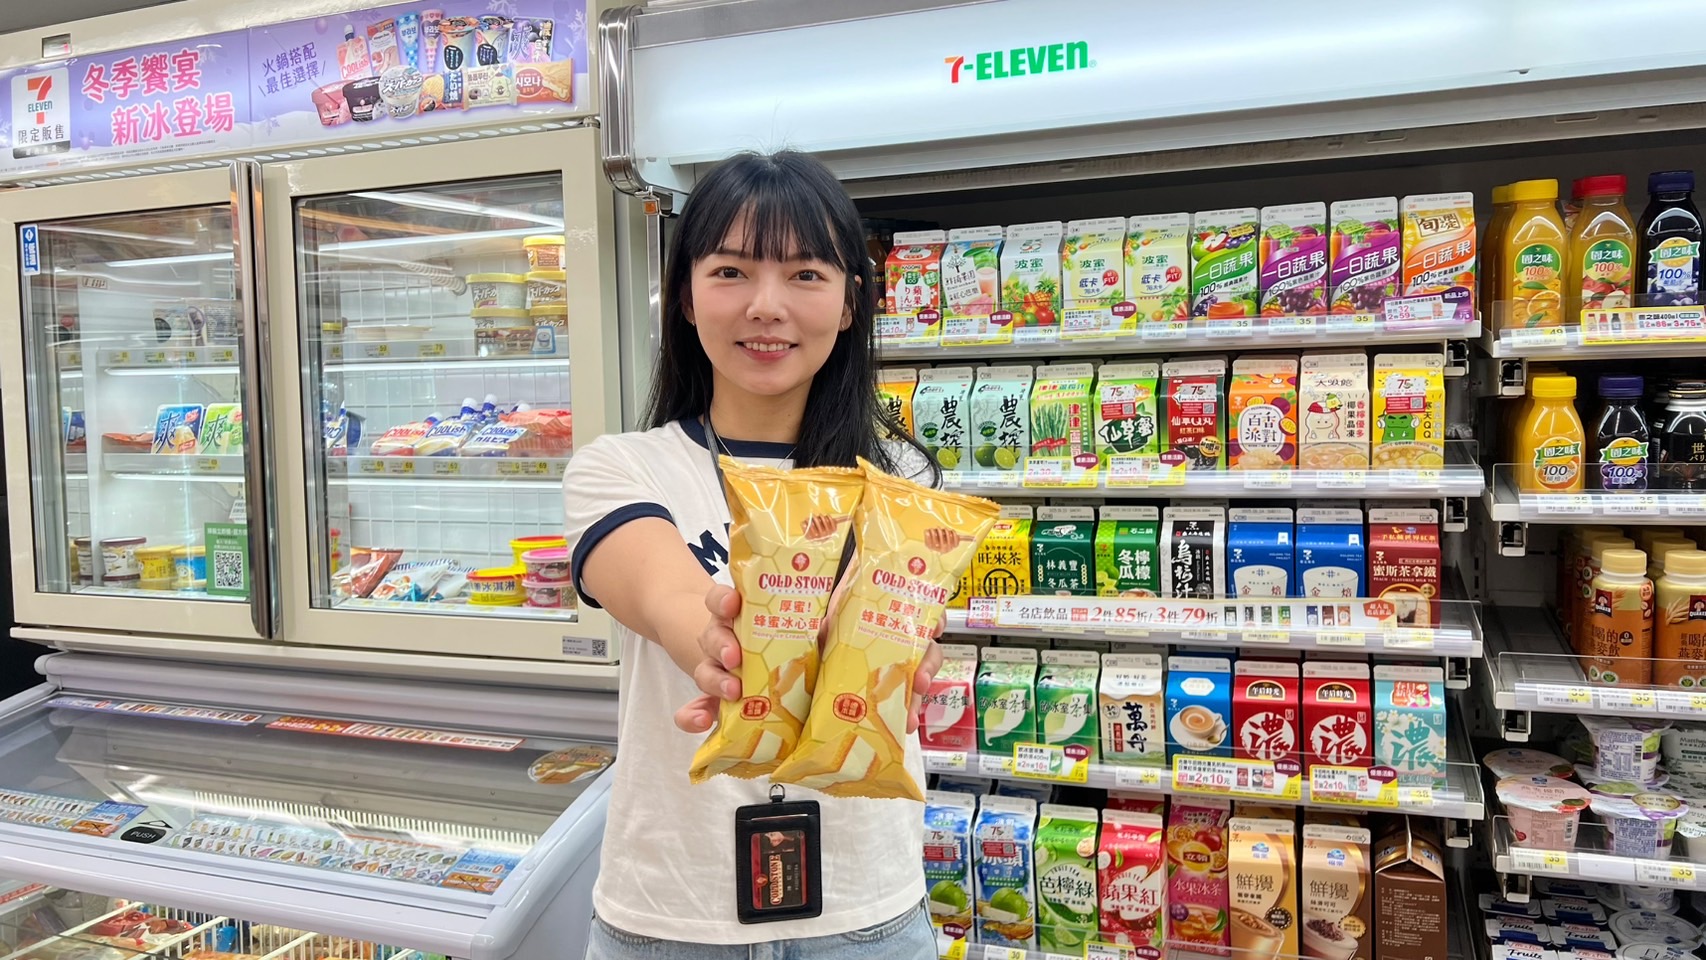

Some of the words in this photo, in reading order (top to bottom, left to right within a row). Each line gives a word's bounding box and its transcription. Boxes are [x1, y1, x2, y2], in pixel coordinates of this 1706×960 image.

[262, 42, 316, 77] 火鍋搭配
[944, 40, 1089, 84] 7-ELEVEn
[82, 47, 202, 104] 冬季饗宴
[265, 60, 319, 95] 最佳選擇
[516, 76, 541, 88] 시모나
[110, 92, 236, 146] 新冰登場
[17, 124, 65, 144] 限定販售
[1407, 239, 1471, 269] 一日蔬果
[1590, 249, 1624, 261] 園之味
[1659, 245, 1695, 258] 園之味
[1014, 257, 1043, 269] 波蜜
[1079, 258, 1105, 269] 波蜜
[1142, 254, 1168, 265] 波蜜
[1194, 251, 1254, 280] 一日蔬果
[1262, 250, 1325, 279] 一日蔬果
[1332, 246, 1398, 275] 一日蔬果
[1521, 254, 1553, 264] 園之味
[1593, 261, 1622, 273] 100%
[1141, 273, 1161, 284] 低卡
[1658, 268, 1691, 280] 100%
[1079, 277, 1098, 288] 低卡
[913, 285, 923, 306] 蘋果
[1444, 291, 1469, 300] 新品上市
[1236, 320, 1248, 328] 35
[940, 395, 965, 453] 農榨
[999, 394, 1024, 453] 農榨
[1171, 415, 1214, 427] 仙草Q丸
[1249, 411, 1276, 429] 百香
[1346, 401, 1356, 438] 椰果晶凍
[1356, 400, 1365, 438] 香檸優多
[155, 412, 181, 454] 爽
[201, 413, 228, 454] 爽
[383, 428, 427, 438] COOLish
[425, 426, 467, 439] COOLish
[481, 425, 519, 437] COOLish
[1099, 416, 1152, 450] 仙草蜜
[1179, 426, 1206, 434] 紅茶口味
[1245, 427, 1277, 443] 派對
[474, 434, 512, 444] カルピス
[1544, 446, 1576, 457] 園之味
[1610, 447, 1644, 458] 園之味
[1542, 464, 1576, 476] 100%
[1608, 466, 1643, 479] 100%
[1130, 527, 1154, 535] 石二鍋
[687, 523, 731, 577] M
[978, 551, 1022, 566] 旺來茶
[1046, 560, 1078, 572] 林義豐
[1373, 565, 1437, 578] 蜜斯茶拿鐵
[759, 573, 792, 590] COLD
[795, 576, 833, 593] STONE
[871, 568, 906, 589] COLD
[907, 577, 948, 605] STONE
[1047, 578, 1079, 590] 冬瓜茶
[779, 599, 811, 613] 厚蜜!
[888, 599, 922, 618] 厚蜜!
[1019, 606, 1068, 621] 名店飲品
[753, 614, 822, 630] 蜂蜜冰心蛋
[752, 630, 773, 639] Honey
[783, 632, 805, 640] Cream
[857, 625, 877, 636] Honey
[878, 631, 889, 639] Ice
[889, 634, 910, 645] Cream
[1252, 687, 1280, 696] 午后時光
[1321, 689, 1352, 699] 午后時光
[980, 692, 1030, 713] 飲冰室茶集
[1040, 697, 1093, 718] 飲冰室茶集
[1122, 701, 1148, 753] 萬丹
[1246, 711, 1291, 762] 濃
[1317, 716, 1364, 764] 濃
[1065, 747, 1087, 755] 優惠活動
[1390, 719, 1442, 771] 濃
[1276, 764, 1300, 772] 優惠活動
[1369, 769, 1394, 778] 優惠活動
[1188, 772, 1231, 785] 第2件10元
[130, 830, 157, 840] PUSH
[1185, 853, 1208, 863] 立頓
[1050, 866, 1068, 875] FRUIT
[1678, 868, 1692, 877] 35
[1040, 876, 1095, 898] 芭檸綠
[1174, 878, 1223, 896] 水果冰茶
[1101, 883, 1159, 907] 蘋果紅
[1554, 903, 1589, 912] Fruits
[944, 926, 964, 934] 優惠活動
[1500, 921, 1534, 931] Fruits
[1564, 931, 1600, 940] Fruits
[1011, 951, 1021, 959] 30
[1137, 948, 1159, 957] 優惠活動
[1507, 949, 1543, 960] Fruits
